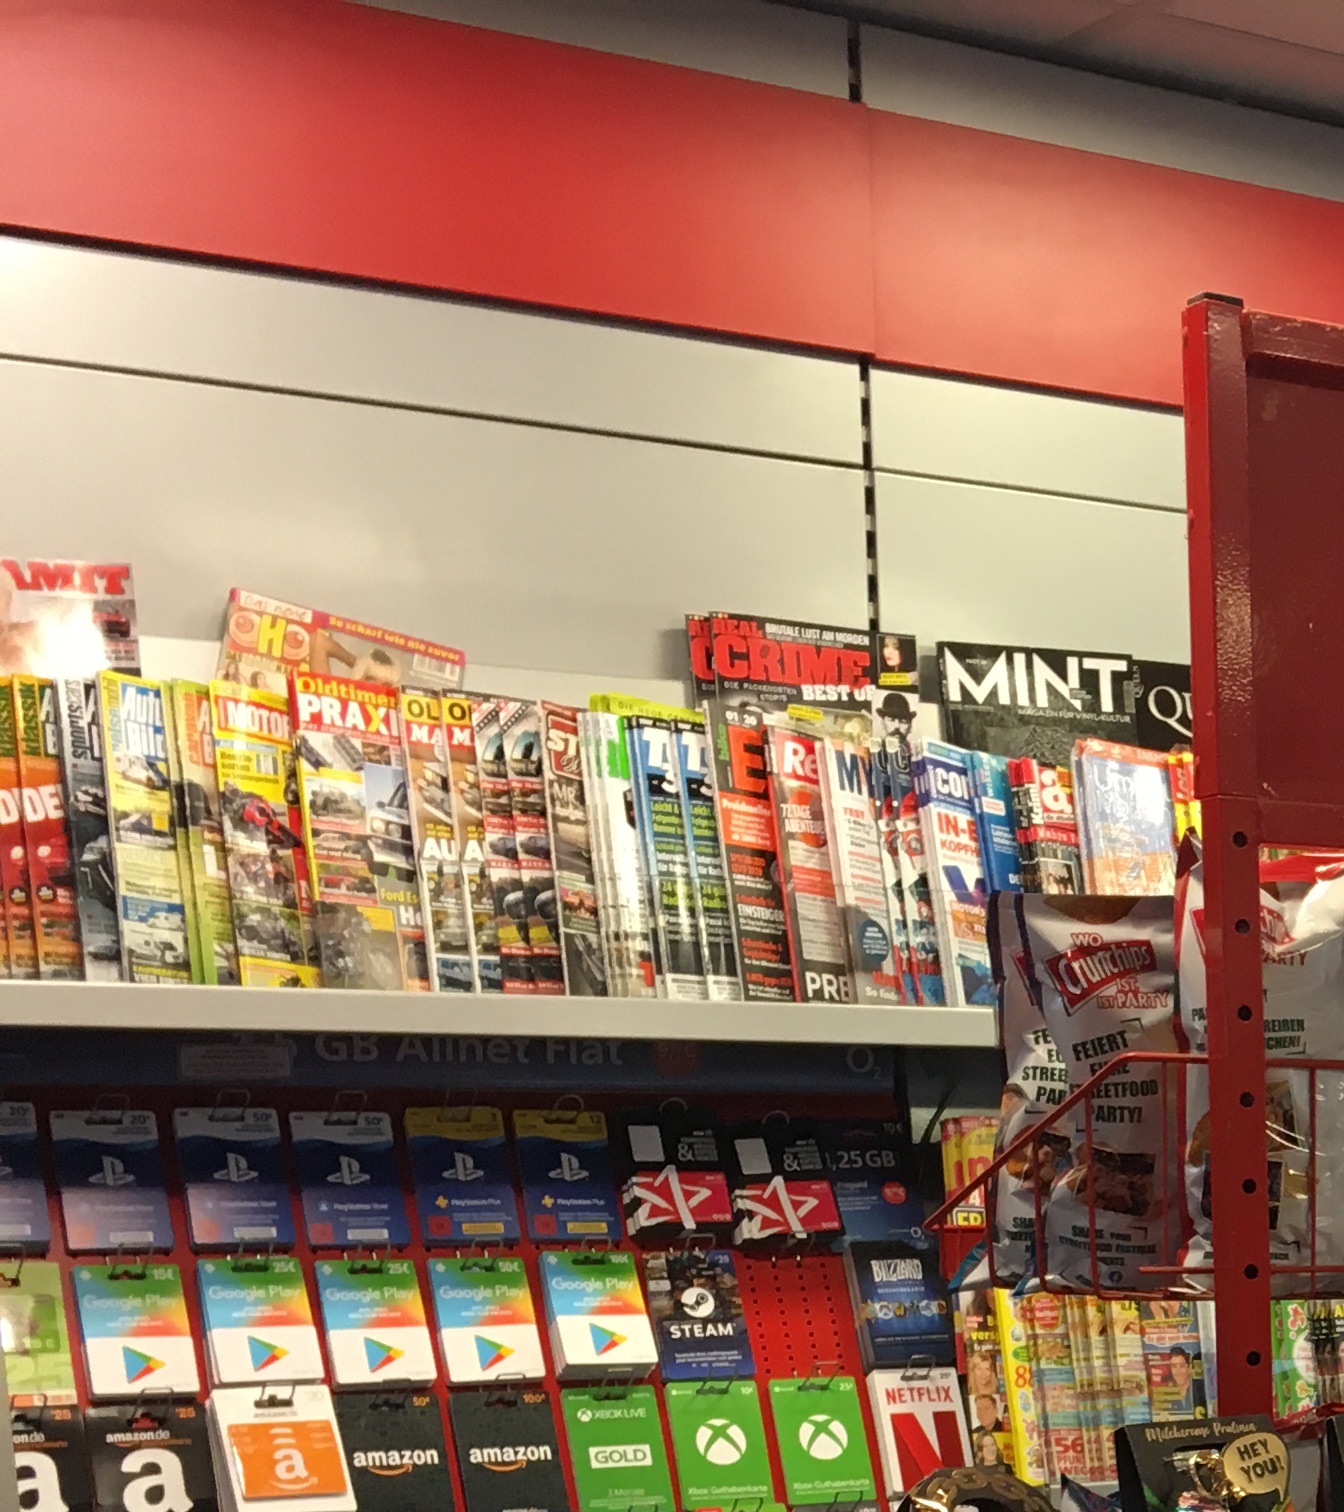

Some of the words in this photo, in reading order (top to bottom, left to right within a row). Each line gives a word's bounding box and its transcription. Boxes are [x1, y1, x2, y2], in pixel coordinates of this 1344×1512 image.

[713, 618, 761, 637] REAL
[764, 622, 800, 638] BRUTALE
[801, 627, 820, 640] LUST
[821, 630, 834, 642] AM
[835, 630, 870, 646] MORDEN
[713, 633, 871, 690] CRIME
[944, 647, 1129, 713] MINT
[801, 684, 840, 702] BEST
[844, 685, 876, 703] OF
[1018, 707, 1057, 720] MAGAZIN
[1071, 932, 1104, 948] WO
[1056, 945, 1150, 997] Crunchips
[1117, 992, 1170, 1009] PARTY
[315, 1033, 380, 1063] GB
[396, 1033, 531, 1066] Allnet
[546, 1037, 623, 1067] Flat
[1072, 1029, 1129, 1062] FEIERT
[866, 1150, 896, 1168] GB
[872, 1257, 923, 1281] BLIZZARD
[209, 1286, 264, 1303] Google
[268, 1285, 302, 1304] Play
[551, 1277, 602, 1293] Google
[605, 1276, 635, 1294] Play
[670, 1323, 735, 1340] STEAM
[884, 1385, 953, 1406] NETFLIX
[594, 1407, 621, 1420] XBOX
[624, 1406, 647, 1419] LIVE
[106, 1429, 170, 1445] amazon.de
[353, 1447, 439, 1469] amazon
[469, 1444, 552, 1466] amazon
[593, 1447, 648, 1465] GOLD
[1236, 1440, 1270, 1462] HEY
[1240, 1454, 1285, 1486] YOU!
